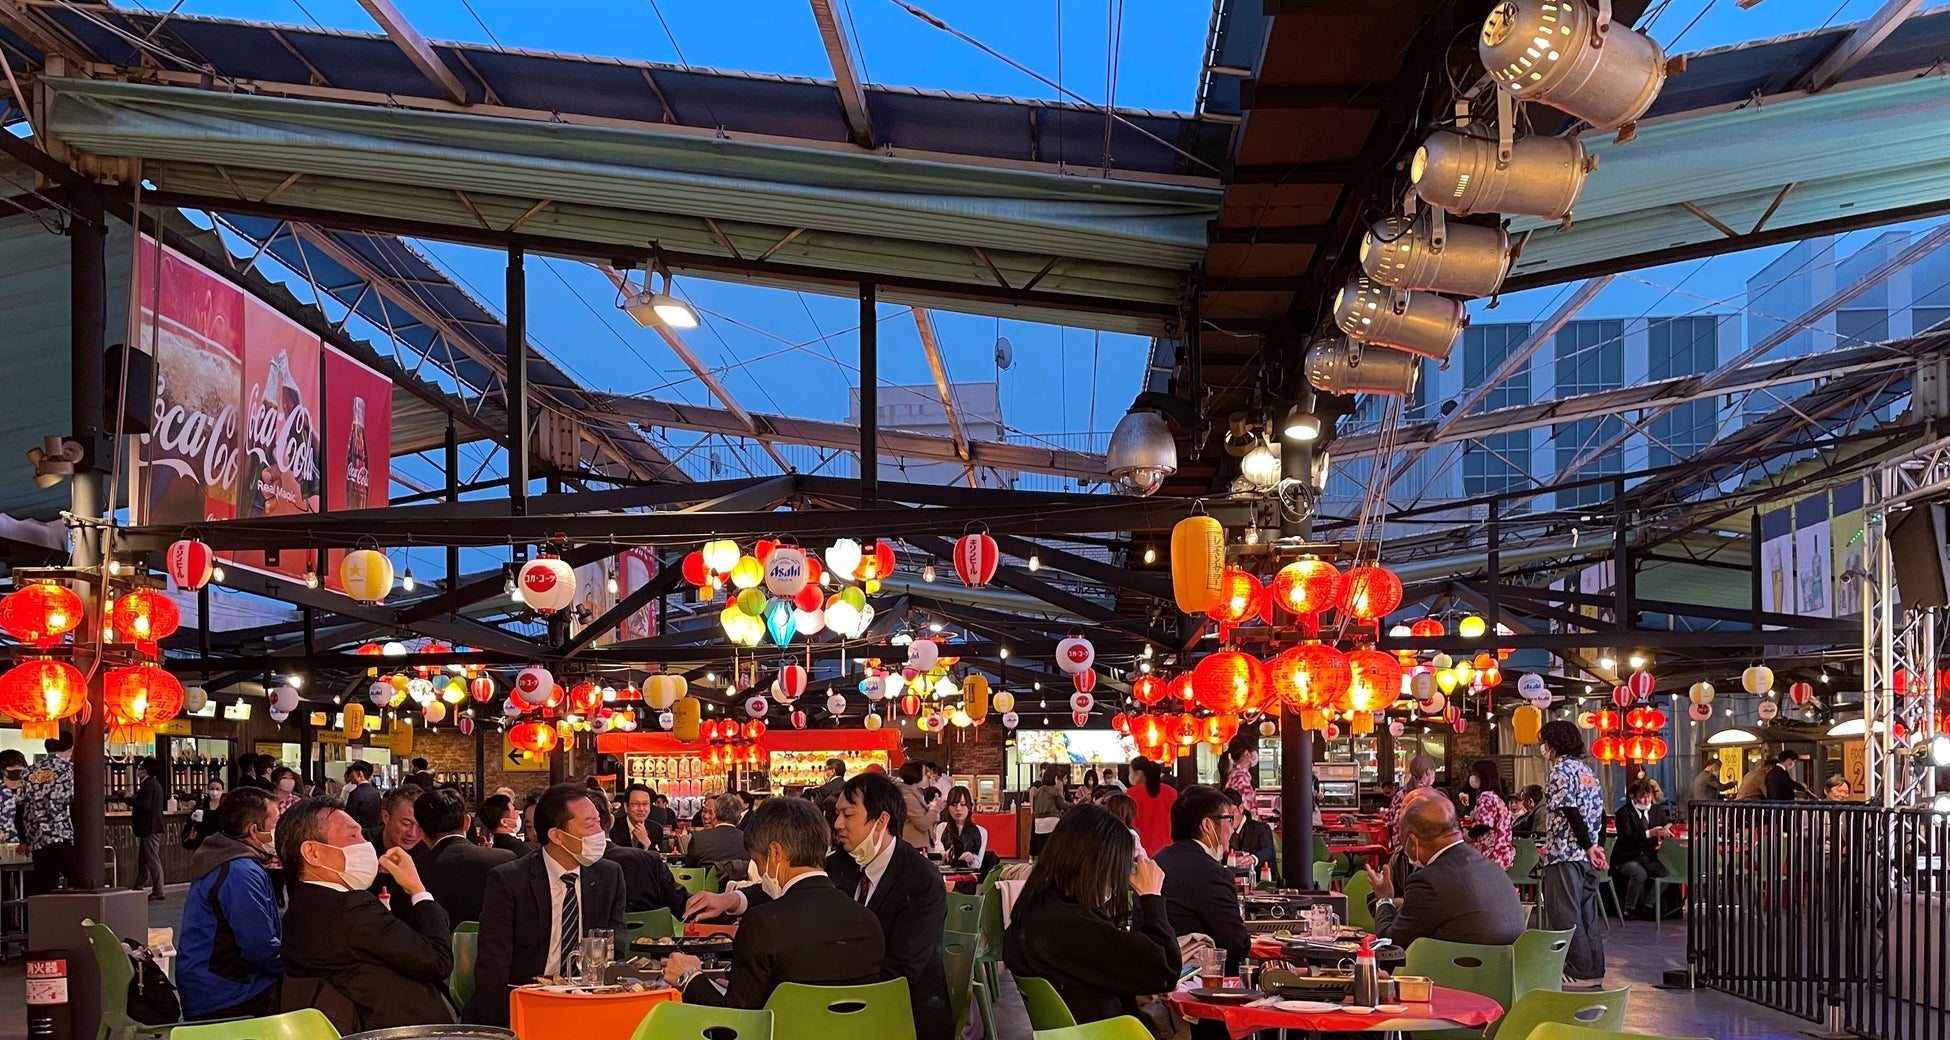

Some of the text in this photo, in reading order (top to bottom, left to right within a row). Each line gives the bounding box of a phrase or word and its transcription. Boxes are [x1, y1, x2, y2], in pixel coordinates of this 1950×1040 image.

[257, 480, 296, 502] Real Magic
[770, 564, 801, 577] Asahi
[1853, 761, 1866, 794] 2
